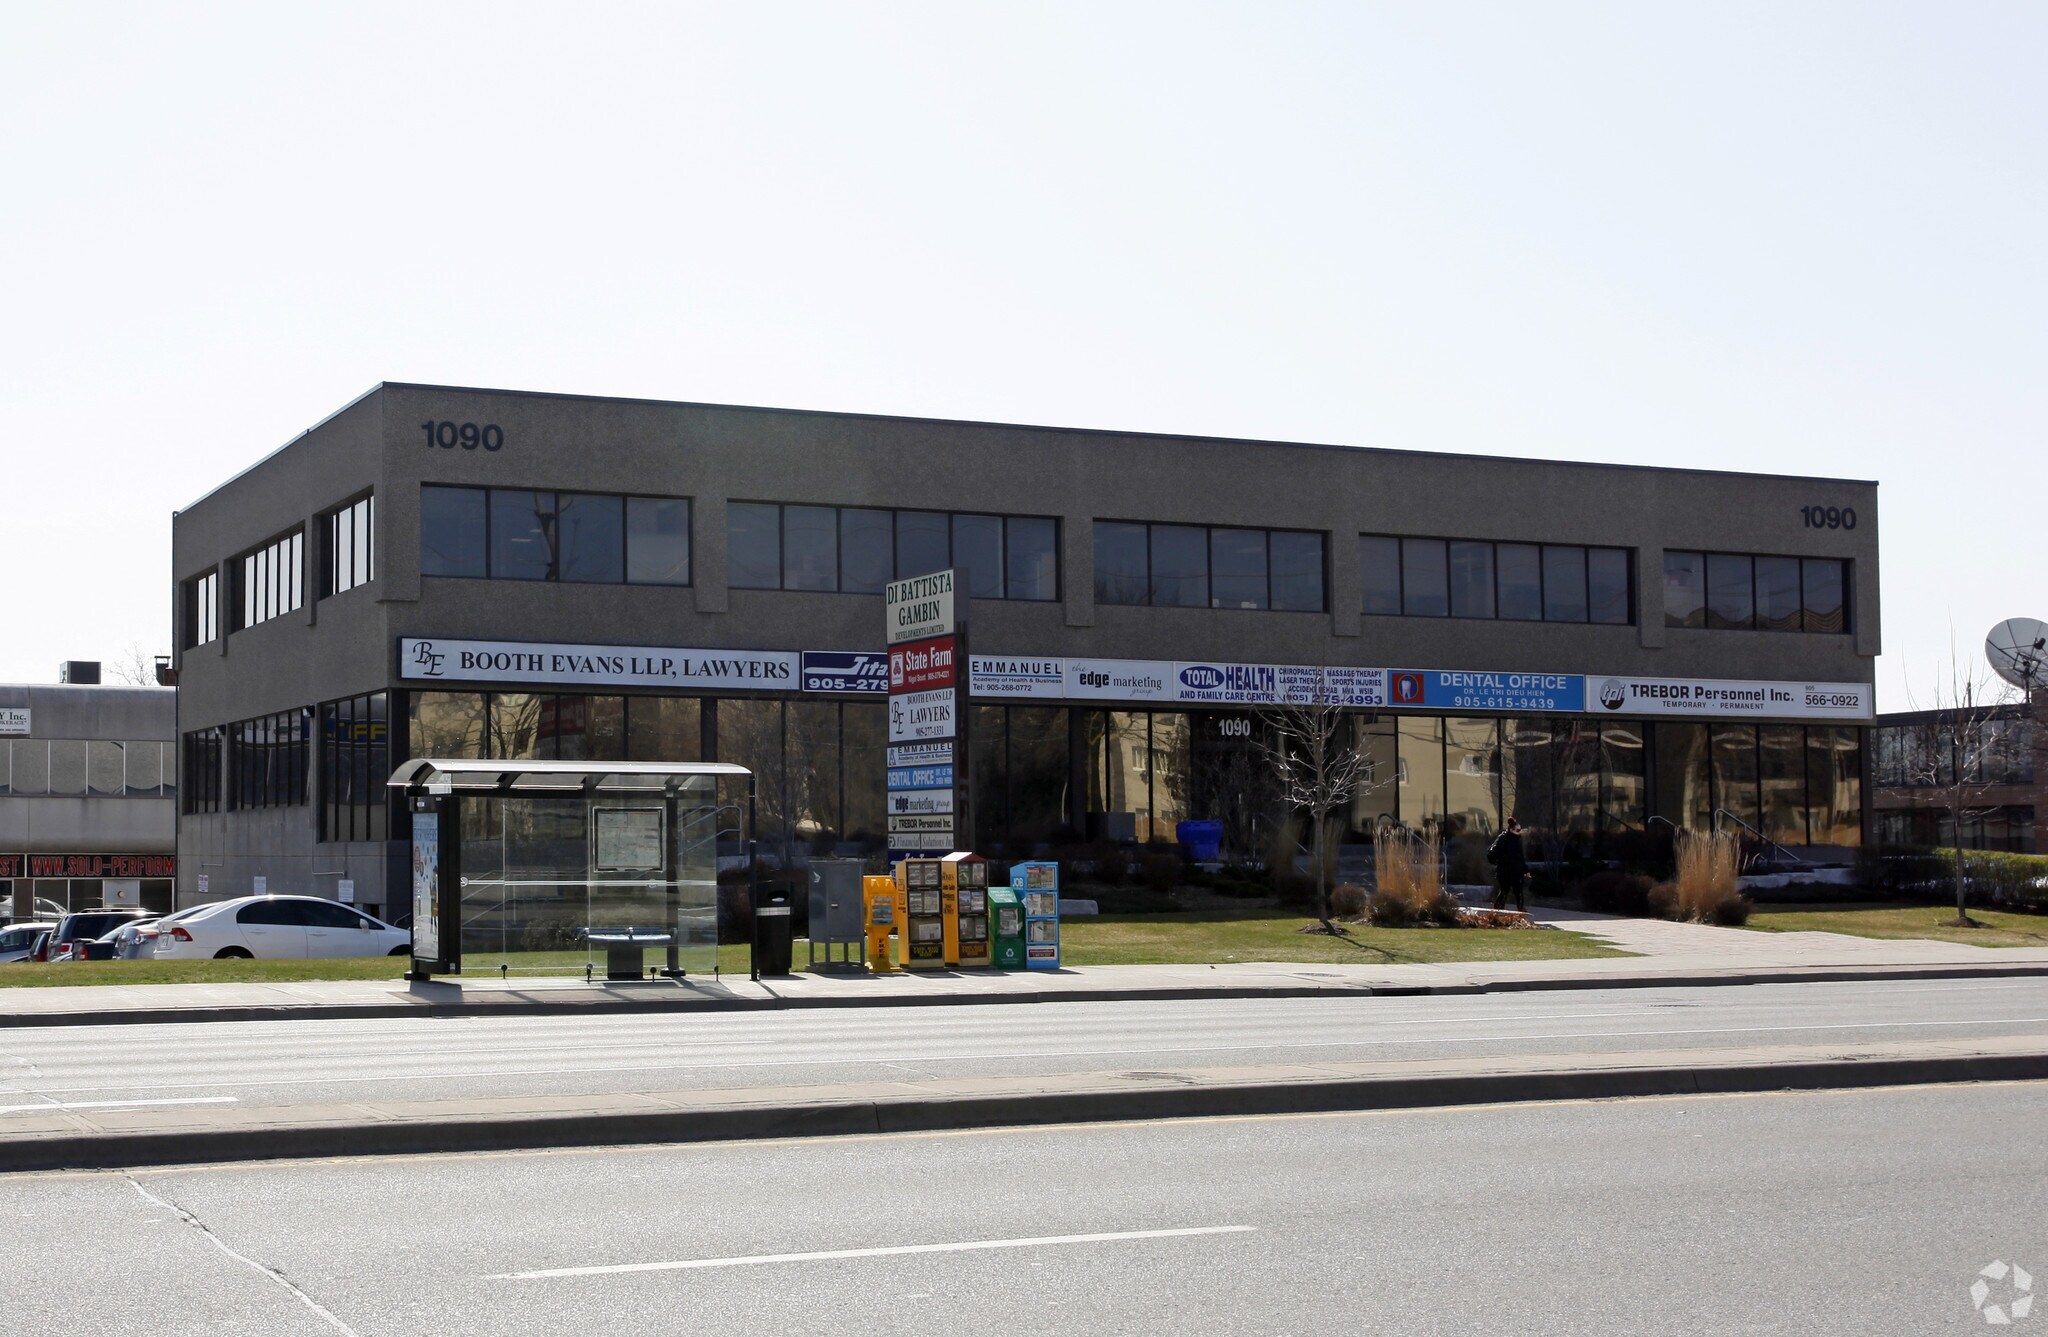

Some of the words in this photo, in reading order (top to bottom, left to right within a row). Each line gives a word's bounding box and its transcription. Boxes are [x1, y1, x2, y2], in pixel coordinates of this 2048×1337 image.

[421, 420, 504, 452] 1090
[1800, 505, 1857, 530] 1090
[887, 584, 898, 605] DI
[901, 573, 952, 602] BATTISTA
[898, 600, 940, 626] GAMBIN
[926, 624, 945, 635] LIMITED
[460, 651, 544, 672] BOOTH
[551, 654, 624, 675] EVANS
[630, 657, 677, 680] LLP,
[683, 658, 790, 680] LAWYERS
[905, 650, 928, 672] State
[930, 646, 952, 668] Farm
[972, 661, 1062, 674] EMMANUEL
[1071, 663, 1086, 672] the
[1327, 669, 1355, 677] MASSAGE
[1356, 670, 1382, 678] THERAPY
[808, 677, 888, 691] 905-279
[1079, 671, 1109, 688] edge
[1113, 676, 1162, 690] marketing
[1185, 669, 1219, 686] TOTAL
[1226, 666, 1275, 691] HEALTH
[1279, 676, 1298, 684] LASER
[1331, 678, 1354, 686] SPORTS
[1355, 679, 1382, 687] INJURIES
[1440, 673, 1504, 688] DENTAL
[1509, 674, 1567, 689] OFFICE
[973, 683, 985, 691] Tel:
[986, 684, 1032, 692] 905-268-0772
[1129, 689, 1153, 697] group
[1288, 685, 1317, 693] ACCIDEN
[1359, 687, 1374, 695] WSIB
[1630, 684, 1690, 699] TREBOR
[1694, 686, 1765, 702] Personnel
[1770, 688, 1794, 702] Inc.
[907, 693, 925, 705] BOOTH
[925, 692, 942, 703] EVANS
[942, 690, 953, 701] LLP
[1180, 690, 1195, 699] AND
[1197, 691, 1223, 700] FAMILY
[1225, 691, 1244, 701] CARE
[1246, 691, 1275, 702] CENTRE
[1283, 694, 1308, 702] (05)
[1454, 696, 1555, 709] 905-615-9439
[1805, 694, 1859, 706] 566-0922
[1662, 700, 1707, 708] TEMPORARY
[1720, 702, 1764, 710] PERMANENT
[9, 711, 27, 721] Inc.
[910, 705, 950, 724] LAWYERS
[1218, 719, 1251, 736] 1090
[897, 743, 952, 754] EMMANUEL
[888, 771, 911, 787] DENTAL
[912, 770, 934, 786] OFFICE
[895, 796, 909, 813] edge
[909, 797, 934, 813] marketing
[898, 819, 917, 829] TREBOR
[918, 818, 942, 828] Personnel
[896, 836, 920, 848] Financial
[922, 836, 944, 848] Solutions
[1012, 877, 1024, 887] JOB
